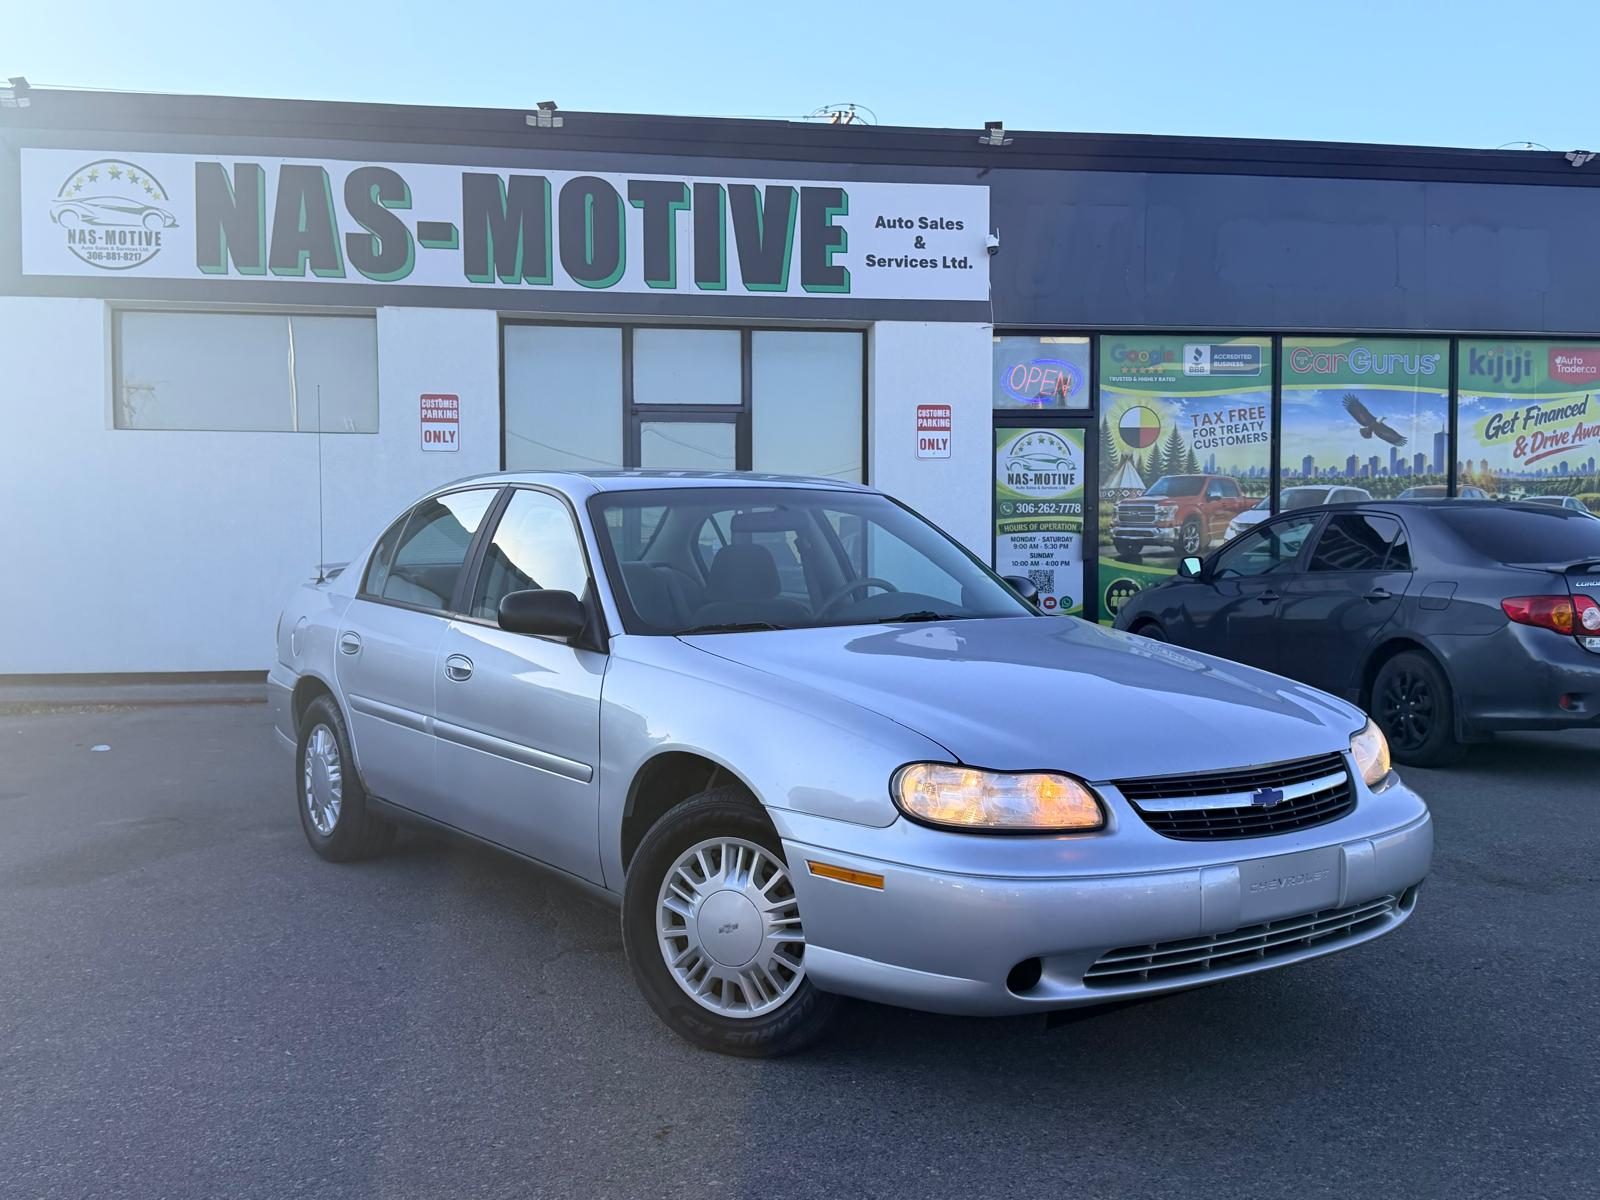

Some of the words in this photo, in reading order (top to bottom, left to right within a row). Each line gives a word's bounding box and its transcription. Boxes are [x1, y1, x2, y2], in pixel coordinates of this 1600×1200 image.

[195, 161, 850, 294] NAS-MOTIVE
[875, 216, 914, 229] Auto
[918, 217, 964, 230] Sales
[67, 229, 161, 246] NAS-MOTIVE
[914, 235, 926, 249] &
[87, 251, 142, 261] 306-881-8217
[865, 254, 938, 269] Services
[942, 256, 973, 269] Ltd.
[1110, 343, 1175, 366] Google
[1560, 356, 1583, 365] Auto
[1468, 346, 1532, 384] kijiji
[1557, 365, 1597, 373] Trader.ca
[1010, 364, 1072, 398] OPEN
[421, 399, 458, 409] CUSTOMER
[421, 409, 458, 419] PARKING
[918, 409, 951, 418] CUSTOMER
[1190, 411, 1225, 427] TAX
[1228, 406, 1266, 423] FREE
[1485, 411, 1520, 440] Get
[1522, 394, 1589, 430] Financed
[918, 418, 951, 428] PARKING
[1192, 427, 1217, 439] FOR
[1219, 420, 1264, 436] TREATY
[424, 430, 456, 443] ONLY
[1194, 432, 1268, 450] CUSTOMERS
[920, 438, 948, 451] ONLY
[1513, 435, 1528, 459] &
[1530, 430, 1569, 454] Drive
[1007, 473, 1075, 485] NAS-MOTIVE
[1016, 503, 1081, 514] 306-262-7778
[1003, 524, 1028, 532] HOURS
[1039, 523, 1077, 531] OPERATION
[1250, 869, 1330, 894] CHEVROLET
